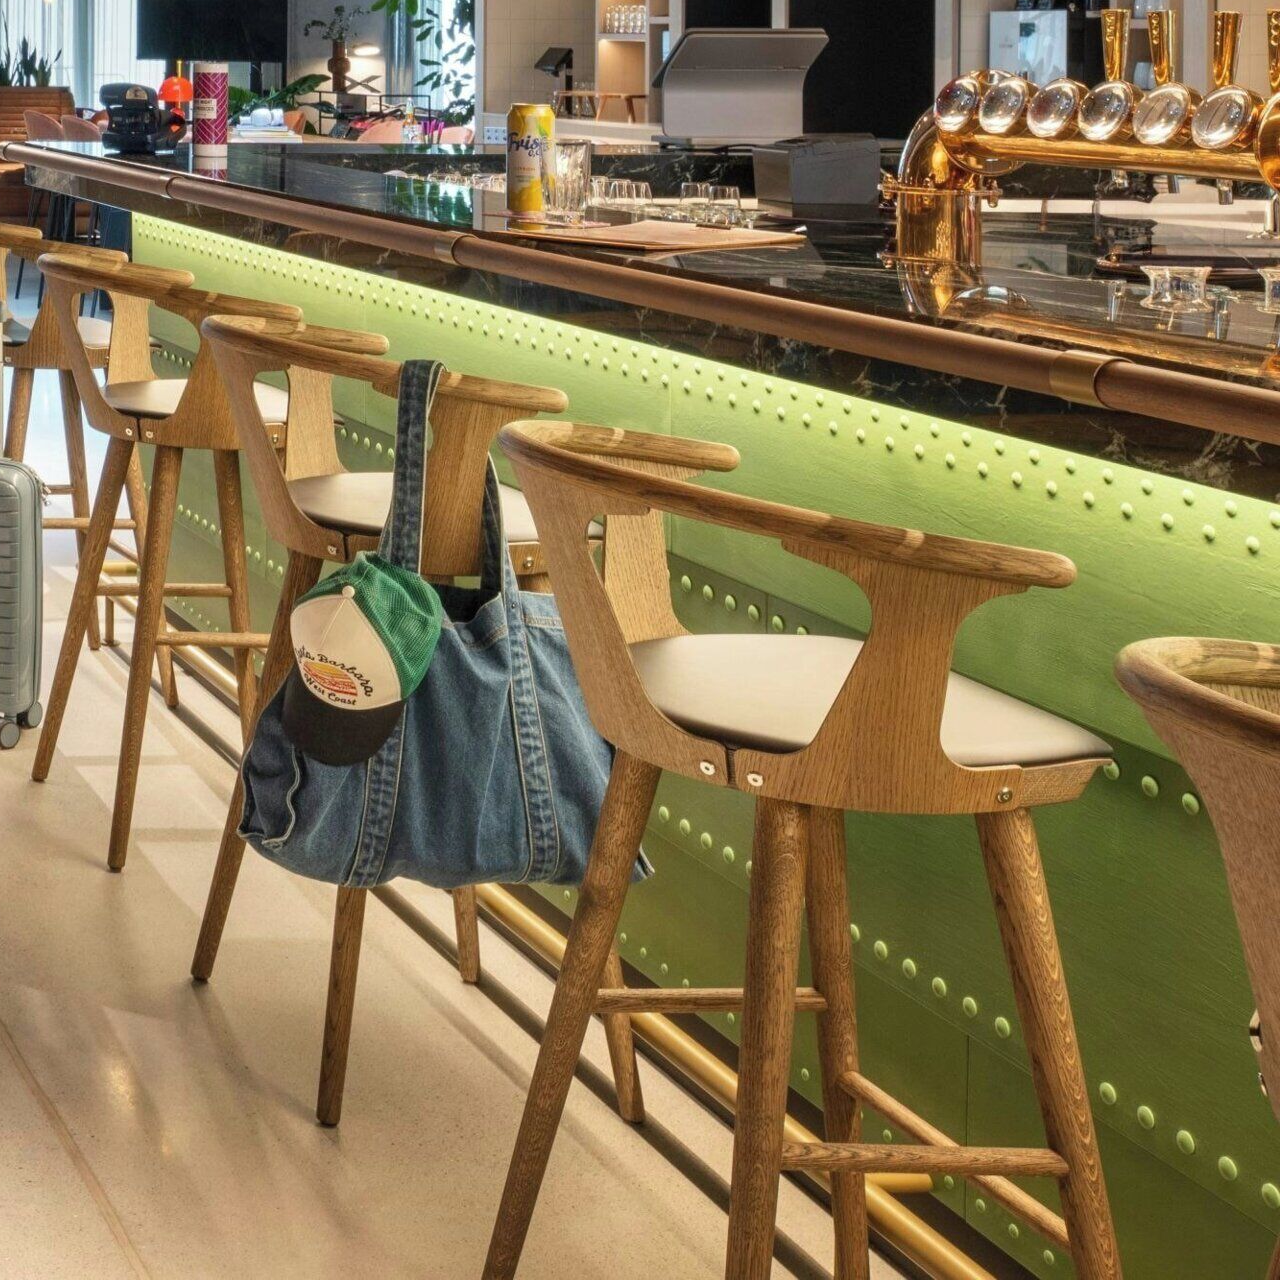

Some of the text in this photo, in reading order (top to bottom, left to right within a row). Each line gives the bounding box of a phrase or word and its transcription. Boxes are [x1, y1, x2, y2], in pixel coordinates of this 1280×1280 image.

[304, 673, 357, 706] West Coast
[317, 653, 374, 698] Barbara
